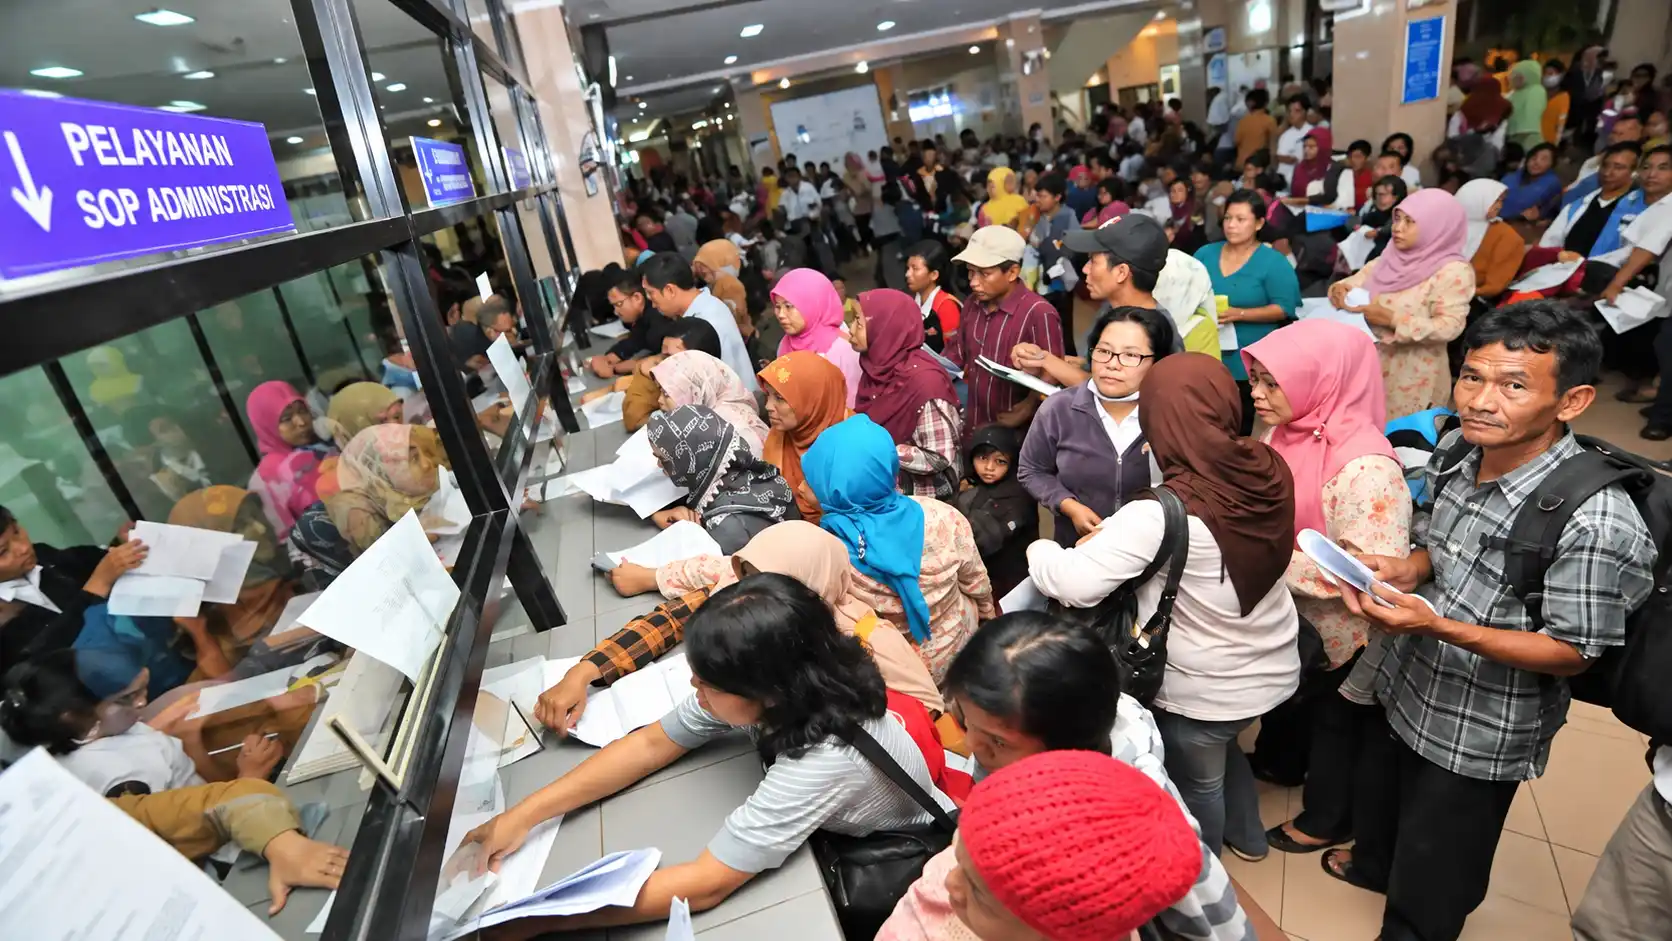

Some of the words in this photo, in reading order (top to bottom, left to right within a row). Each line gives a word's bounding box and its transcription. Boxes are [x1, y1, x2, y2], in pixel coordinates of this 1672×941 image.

[60, 121, 234, 167] PELAYANAN
[76, 188, 140, 229] SOP
[147, 184, 275, 223] ADMINISTRASI
